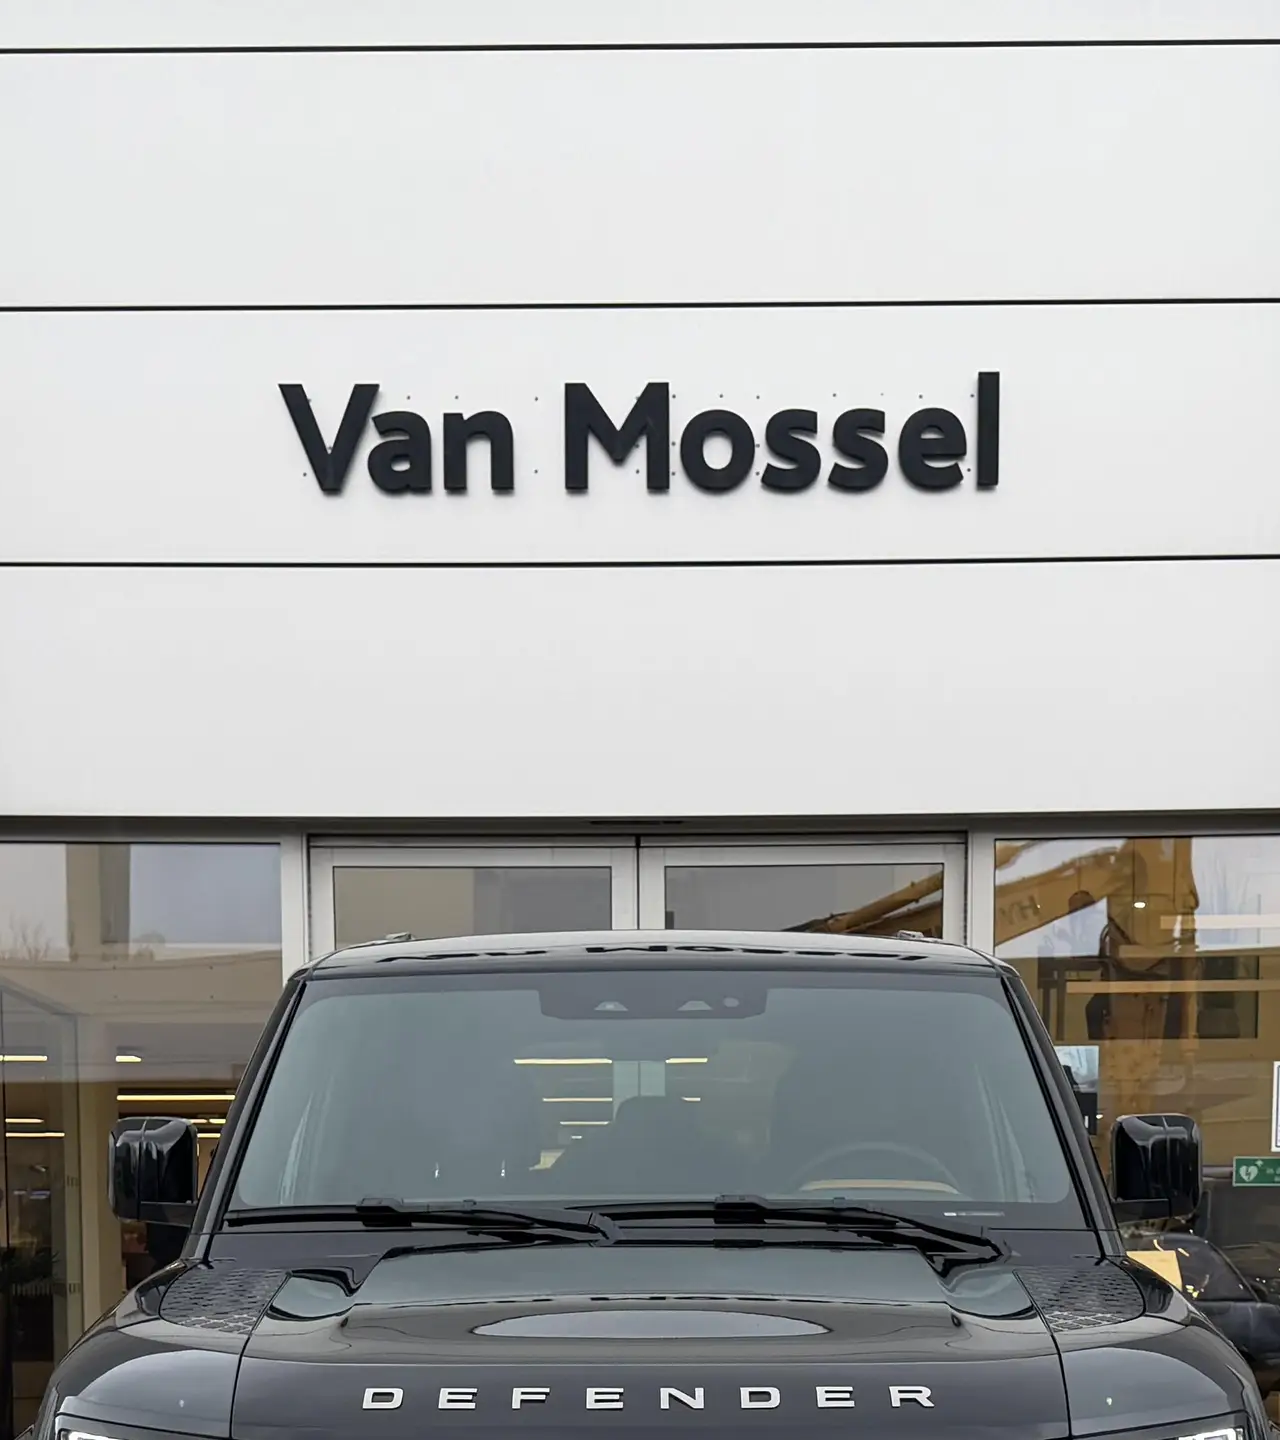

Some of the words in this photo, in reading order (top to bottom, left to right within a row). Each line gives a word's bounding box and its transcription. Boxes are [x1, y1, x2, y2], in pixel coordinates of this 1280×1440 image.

[278, 383, 514, 494] Van
[564, 371, 1000, 494] Mossel
[362, 1386, 935, 1410] DEFENDER
